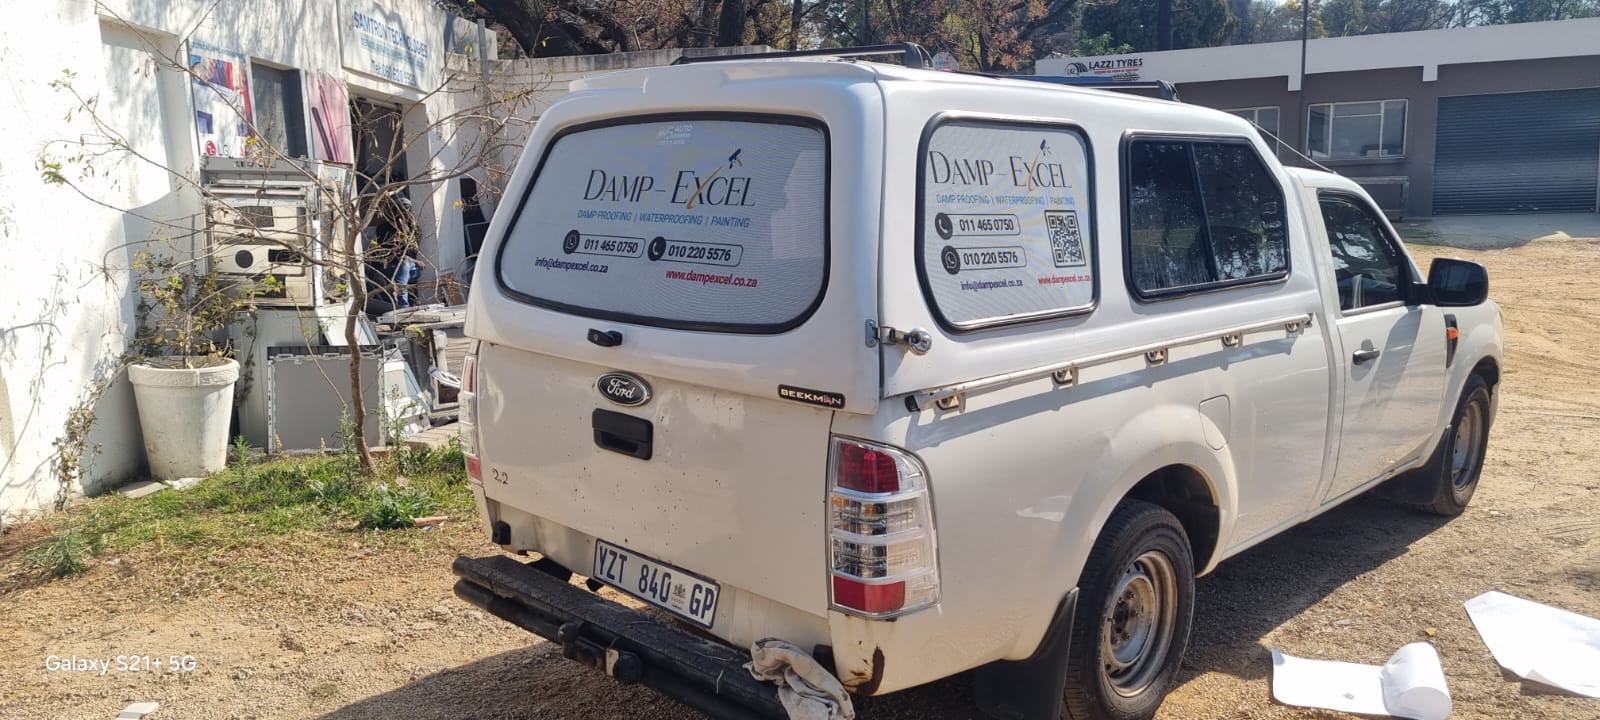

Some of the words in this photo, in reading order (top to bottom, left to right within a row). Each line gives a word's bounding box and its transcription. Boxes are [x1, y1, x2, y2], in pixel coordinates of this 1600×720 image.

[1089, 60, 1114, 69] LAZZI
[1116, 58, 1143, 67] TYRES
[218, 145, 230, 156] LG
[936, 194, 956, 204] DAMP
[577, 209, 597, 219] DAMP
[597, 210, 632, 221] PROOFING
[639, 212, 703, 225] WATERPROOFING
[710, 216, 750, 228] PAINTING
[959, 219, 974, 232] 011
[977, 219, 993, 231] 465
[994, 219, 1014, 231] 0750
[584, 239, 599, 250] 011
[600, 239, 616, 251] 465
[617, 241, 638, 254] 0750
[668, 244, 686, 258] 010
[687, 246, 705, 260] 220
[706, 247, 731, 261] 5576
[534, 256, 608, 274] info@dampexcel.co.za
[963, 252, 979, 265] 010
[981, 252, 997, 265] 220
[998, 251, 1018, 264] 5576
[665, 269, 757, 288] www.dampexcel.co.za
[607, 377, 634, 399] Ford
[781, 388, 842, 406] BEEKMAN
[599, 546, 627, 583] YZT
[638, 564, 671, 602] 840
[689, 583, 714, 619] GP
